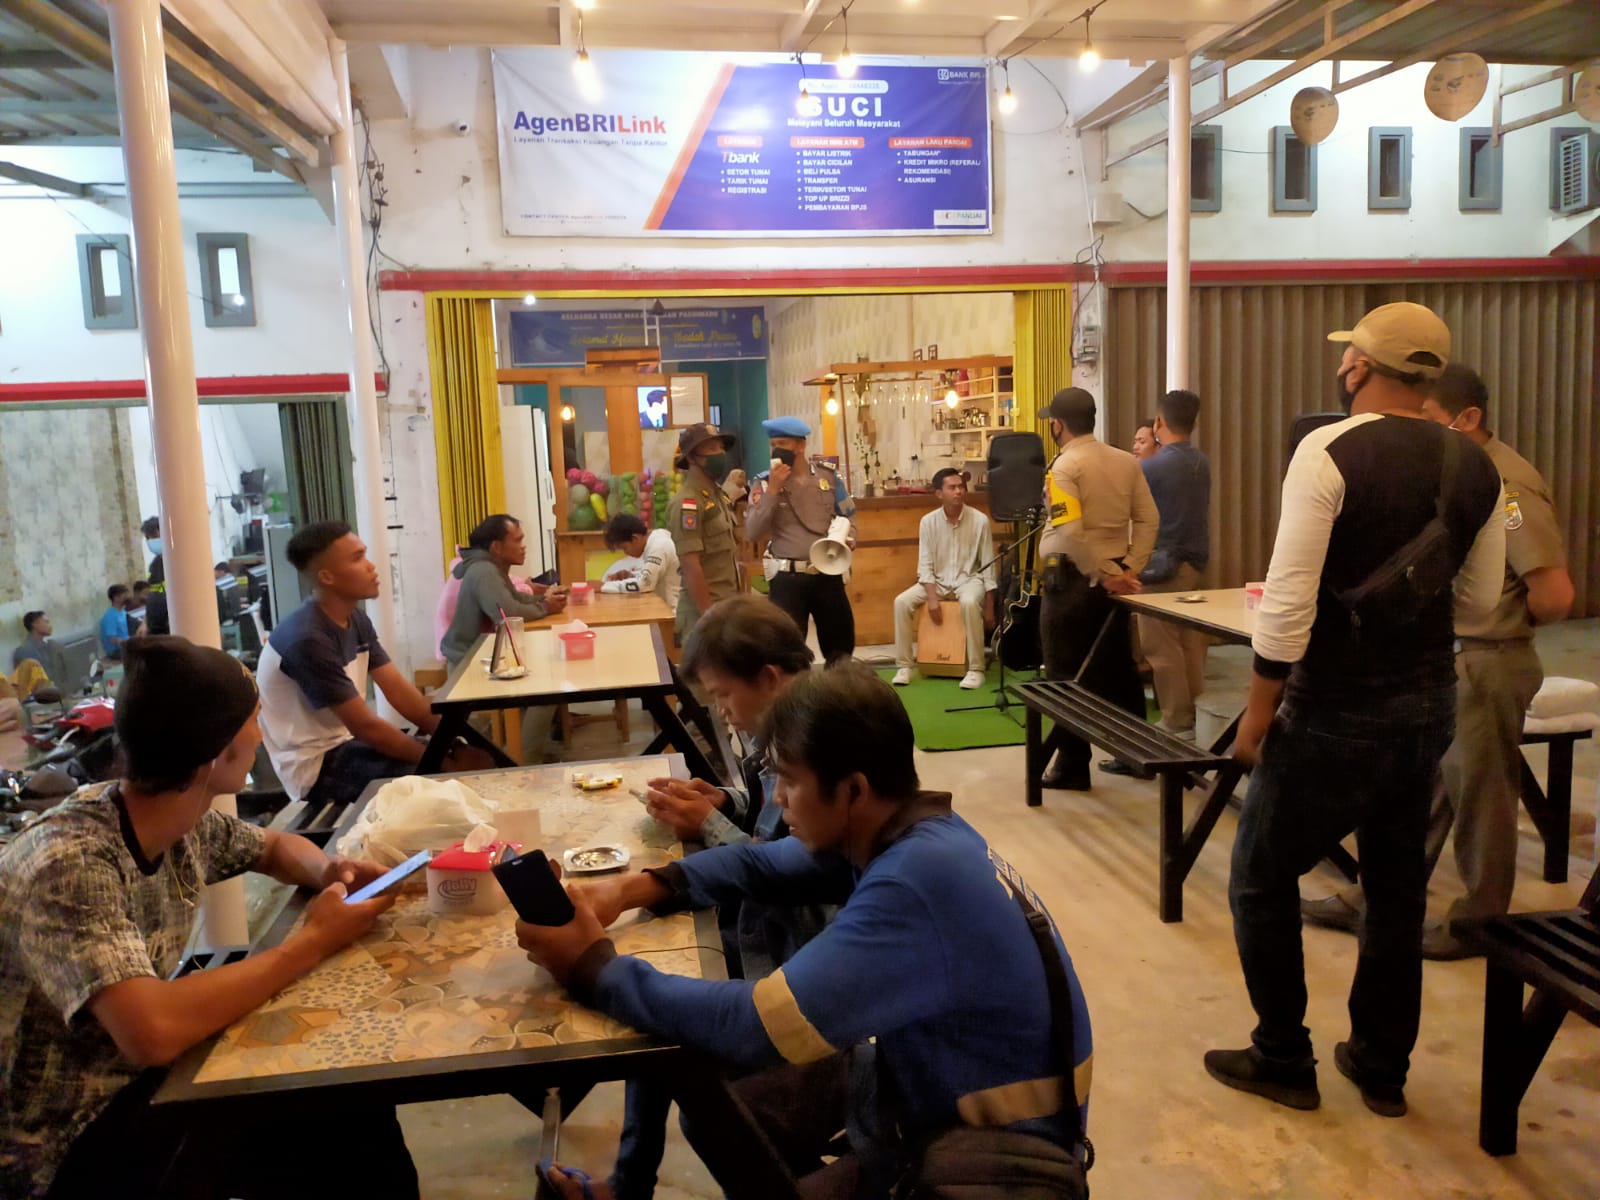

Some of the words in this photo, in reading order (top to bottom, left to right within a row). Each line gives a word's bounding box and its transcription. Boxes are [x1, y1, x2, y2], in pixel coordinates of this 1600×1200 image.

[949, 71, 969, 79] BANK
[797, 96, 882, 117] SUCI
[514, 111, 667, 136] AgenBRILink
[824, 119, 855, 128] Seluruh
[856, 119, 901, 129] Masyarakat
